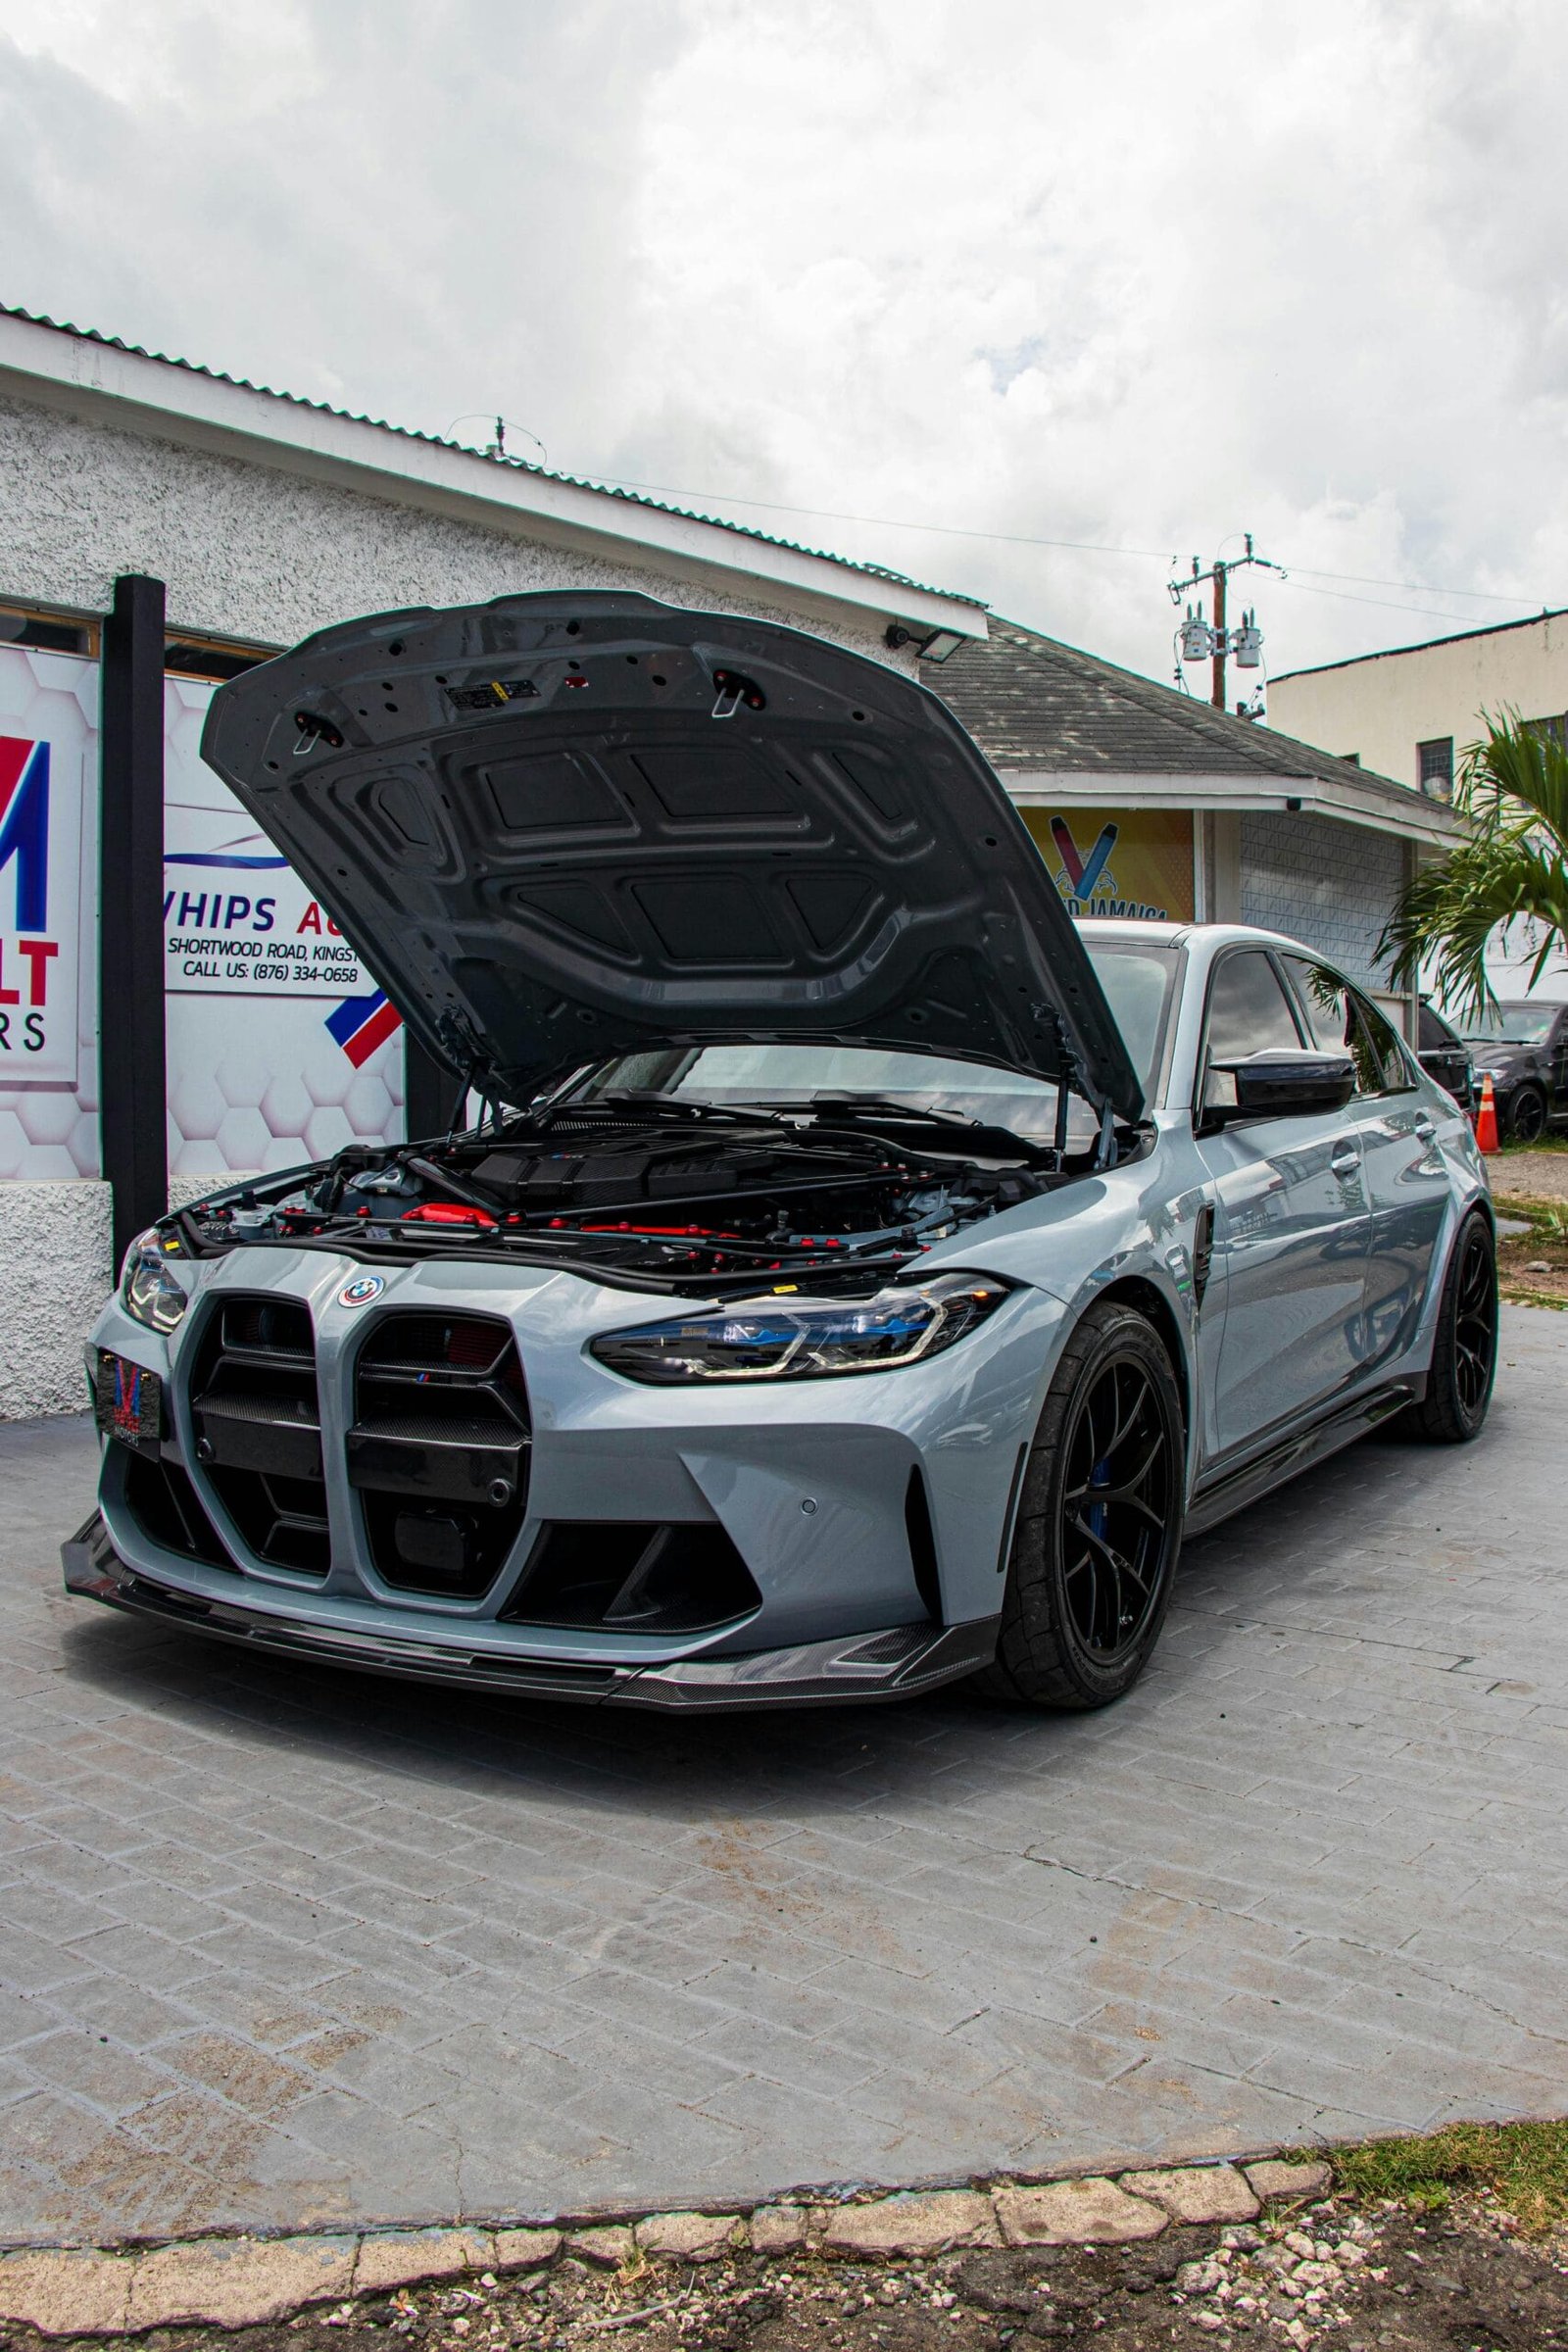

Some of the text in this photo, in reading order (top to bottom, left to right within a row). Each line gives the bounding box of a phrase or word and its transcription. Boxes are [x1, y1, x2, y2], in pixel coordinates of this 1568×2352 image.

[168, 938, 263, 957] SHORTWOOD
[267, 944, 309, 961] ROAD,
[183, 960, 358, 983] CALL US: (876) 334-0658
